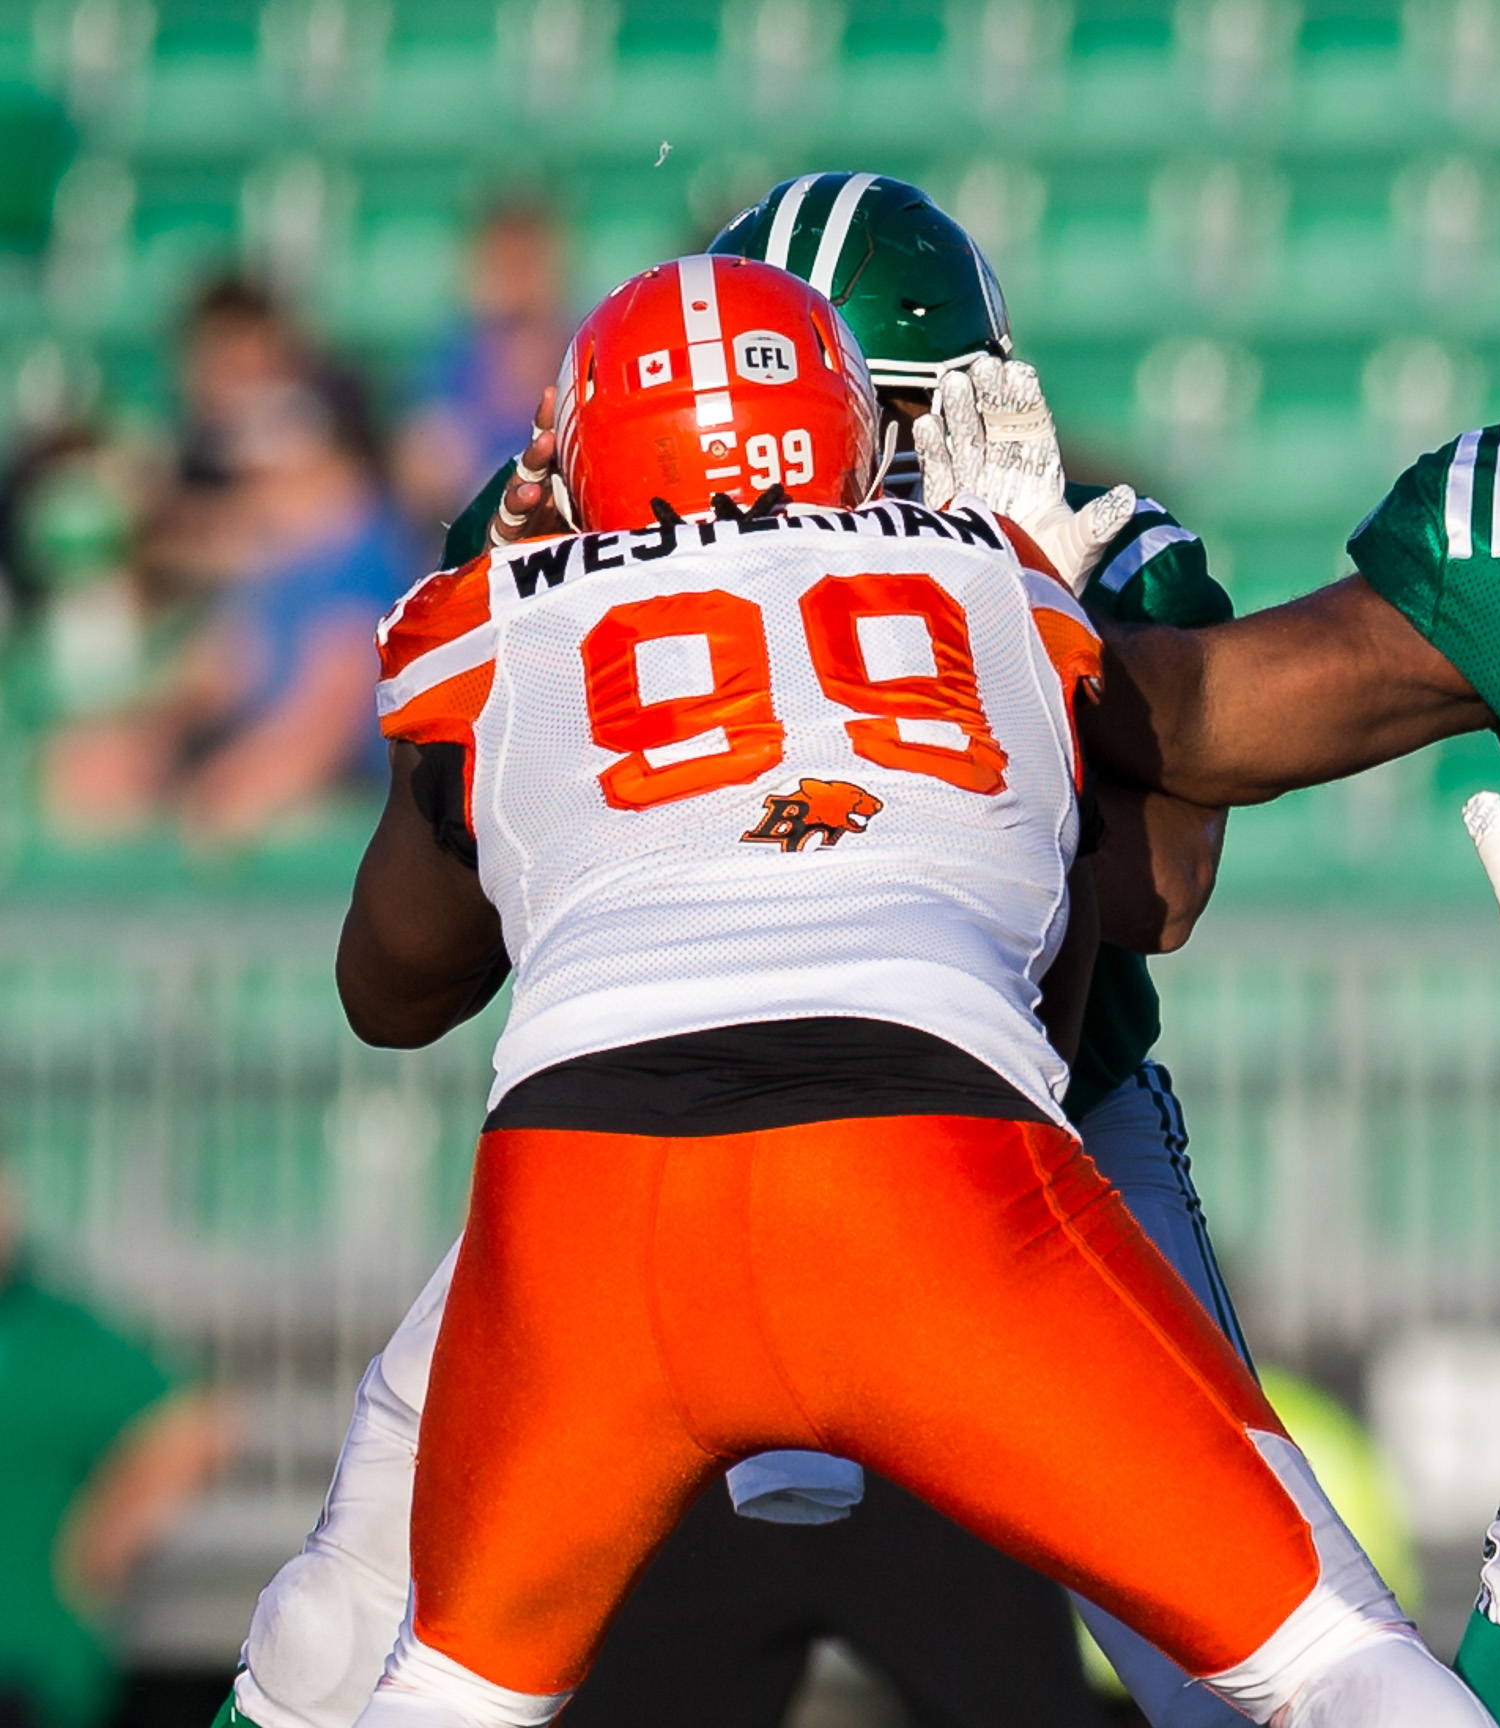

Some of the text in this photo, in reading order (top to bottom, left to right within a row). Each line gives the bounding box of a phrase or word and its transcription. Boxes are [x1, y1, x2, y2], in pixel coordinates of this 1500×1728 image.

[744, 346, 790, 371] CFL
[745, 428, 815, 491] 99
[508, 502, 1004, 600] WESMAN
[578, 572, 1009, 812] 99
